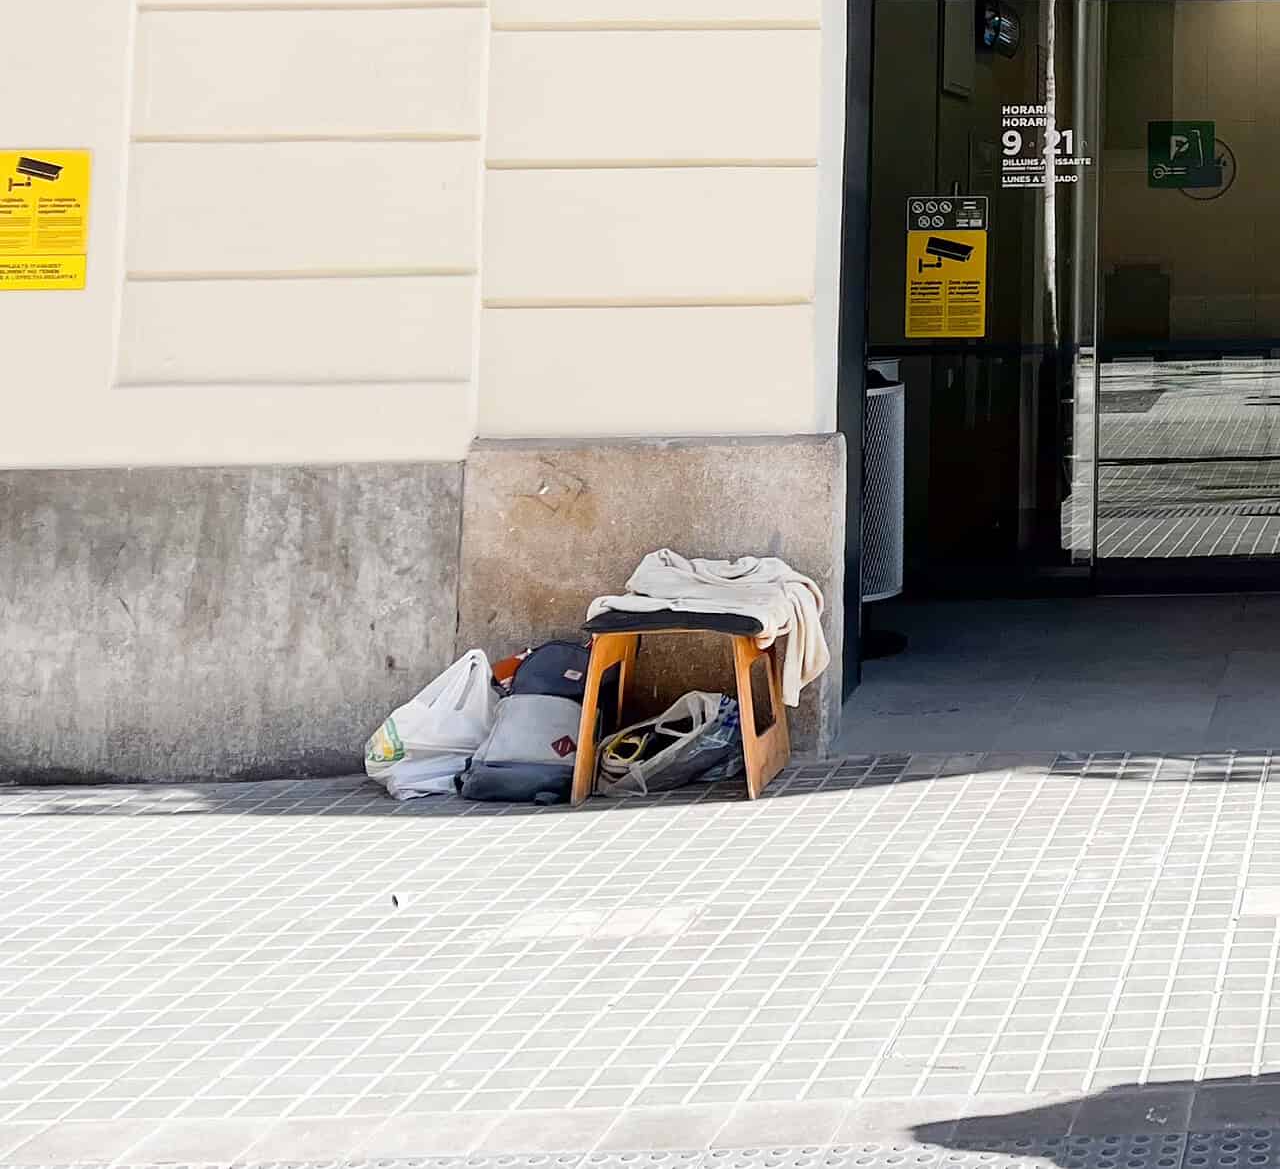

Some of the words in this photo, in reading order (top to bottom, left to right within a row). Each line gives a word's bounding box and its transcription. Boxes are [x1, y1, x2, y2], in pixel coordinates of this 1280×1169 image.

[1002, 130, 1022, 156] 9
[1042, 129, 1073, 156] 21
[1002, 157, 1039, 166] DILLUNS
[1002, 175, 1031, 183] LUNES
